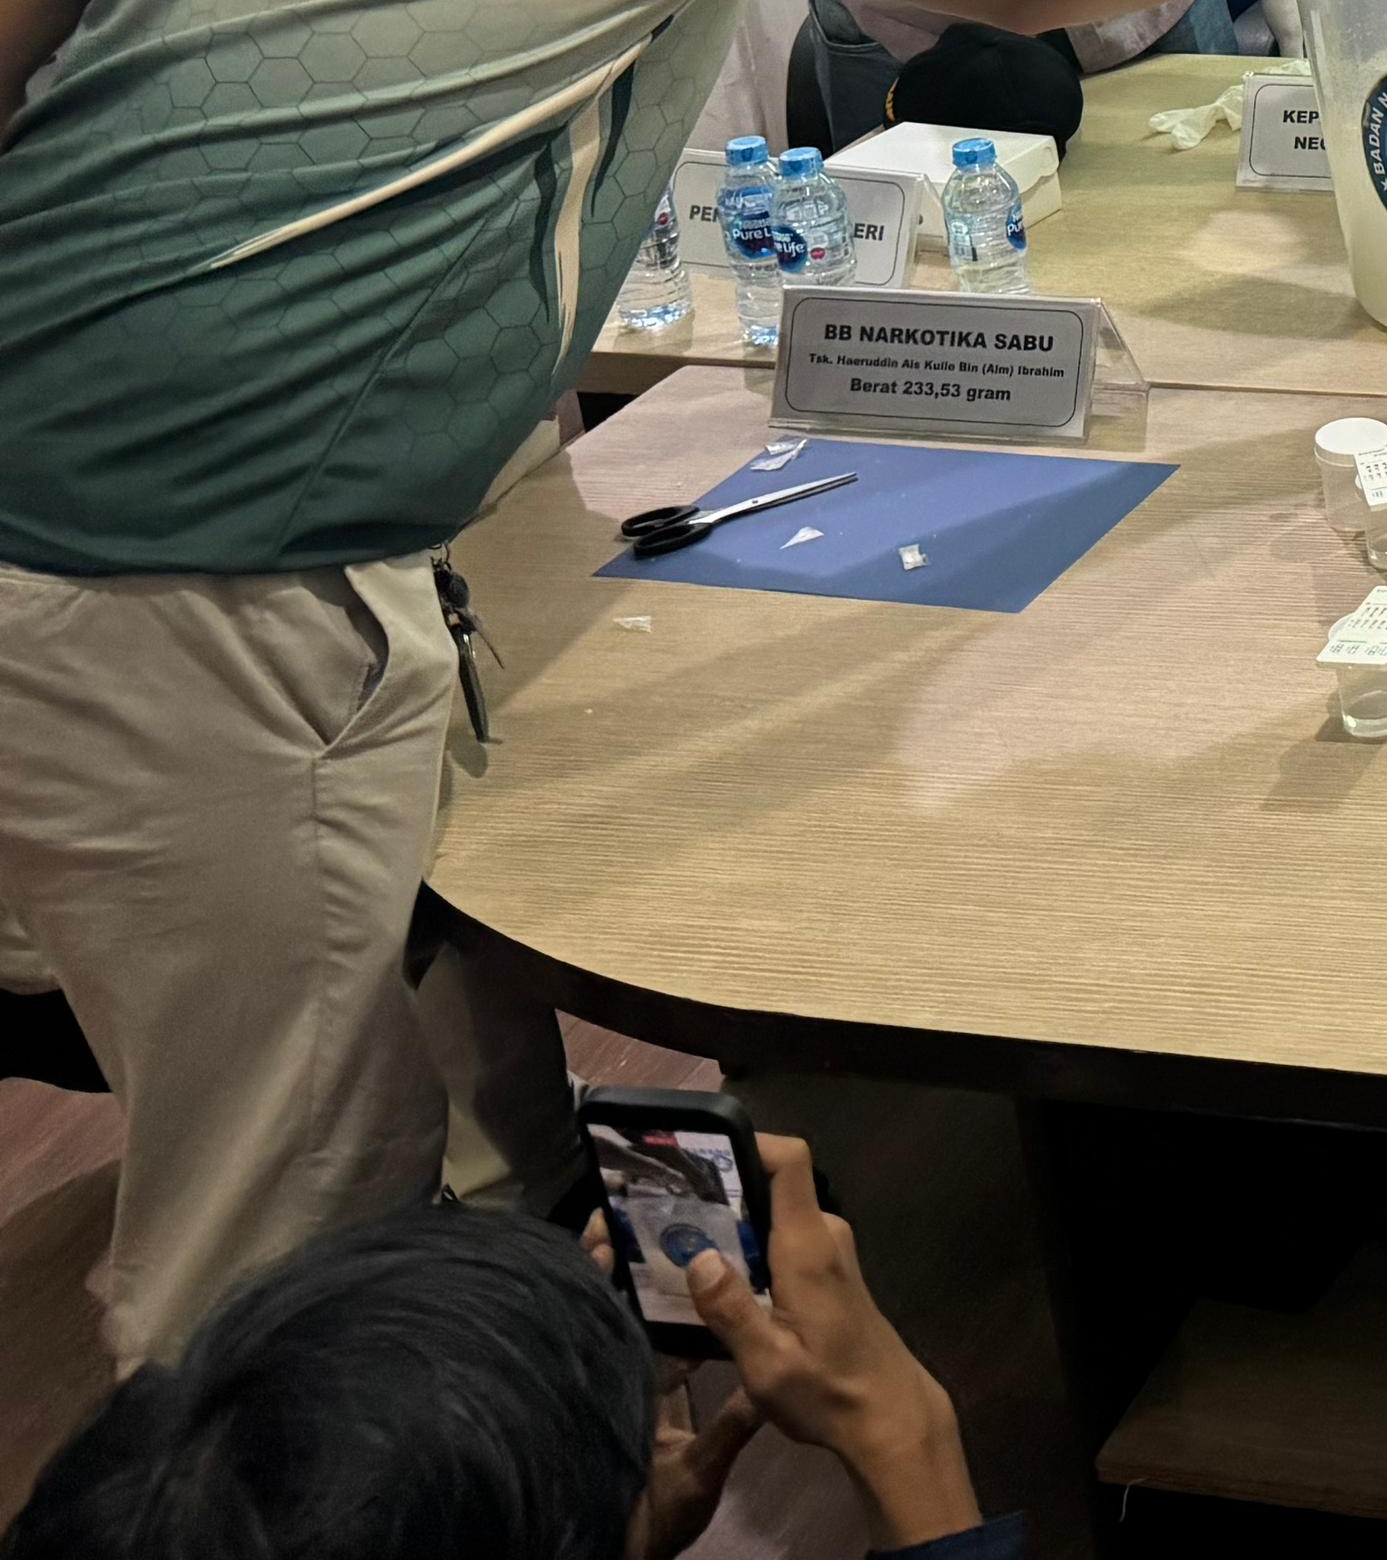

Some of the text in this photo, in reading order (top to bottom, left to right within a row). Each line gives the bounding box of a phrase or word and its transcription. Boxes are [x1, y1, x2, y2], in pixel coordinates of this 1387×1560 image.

[1283, 110, 1319, 124] KEP
[1369, 108, 1384, 175] BADAN
[824, 324, 1054, 352] BB NARKOTIKA SABU
[809, 353, 833, 364] Tsk.
[837, 355, 898, 368] Haeruddin
[959, 362, 978, 372] Bin
[982, 363, 1014, 377] (Alm)
[1018, 365, 1065, 377] Ibrahim
[850, 378, 1011, 402] Berat 233,53 gram
